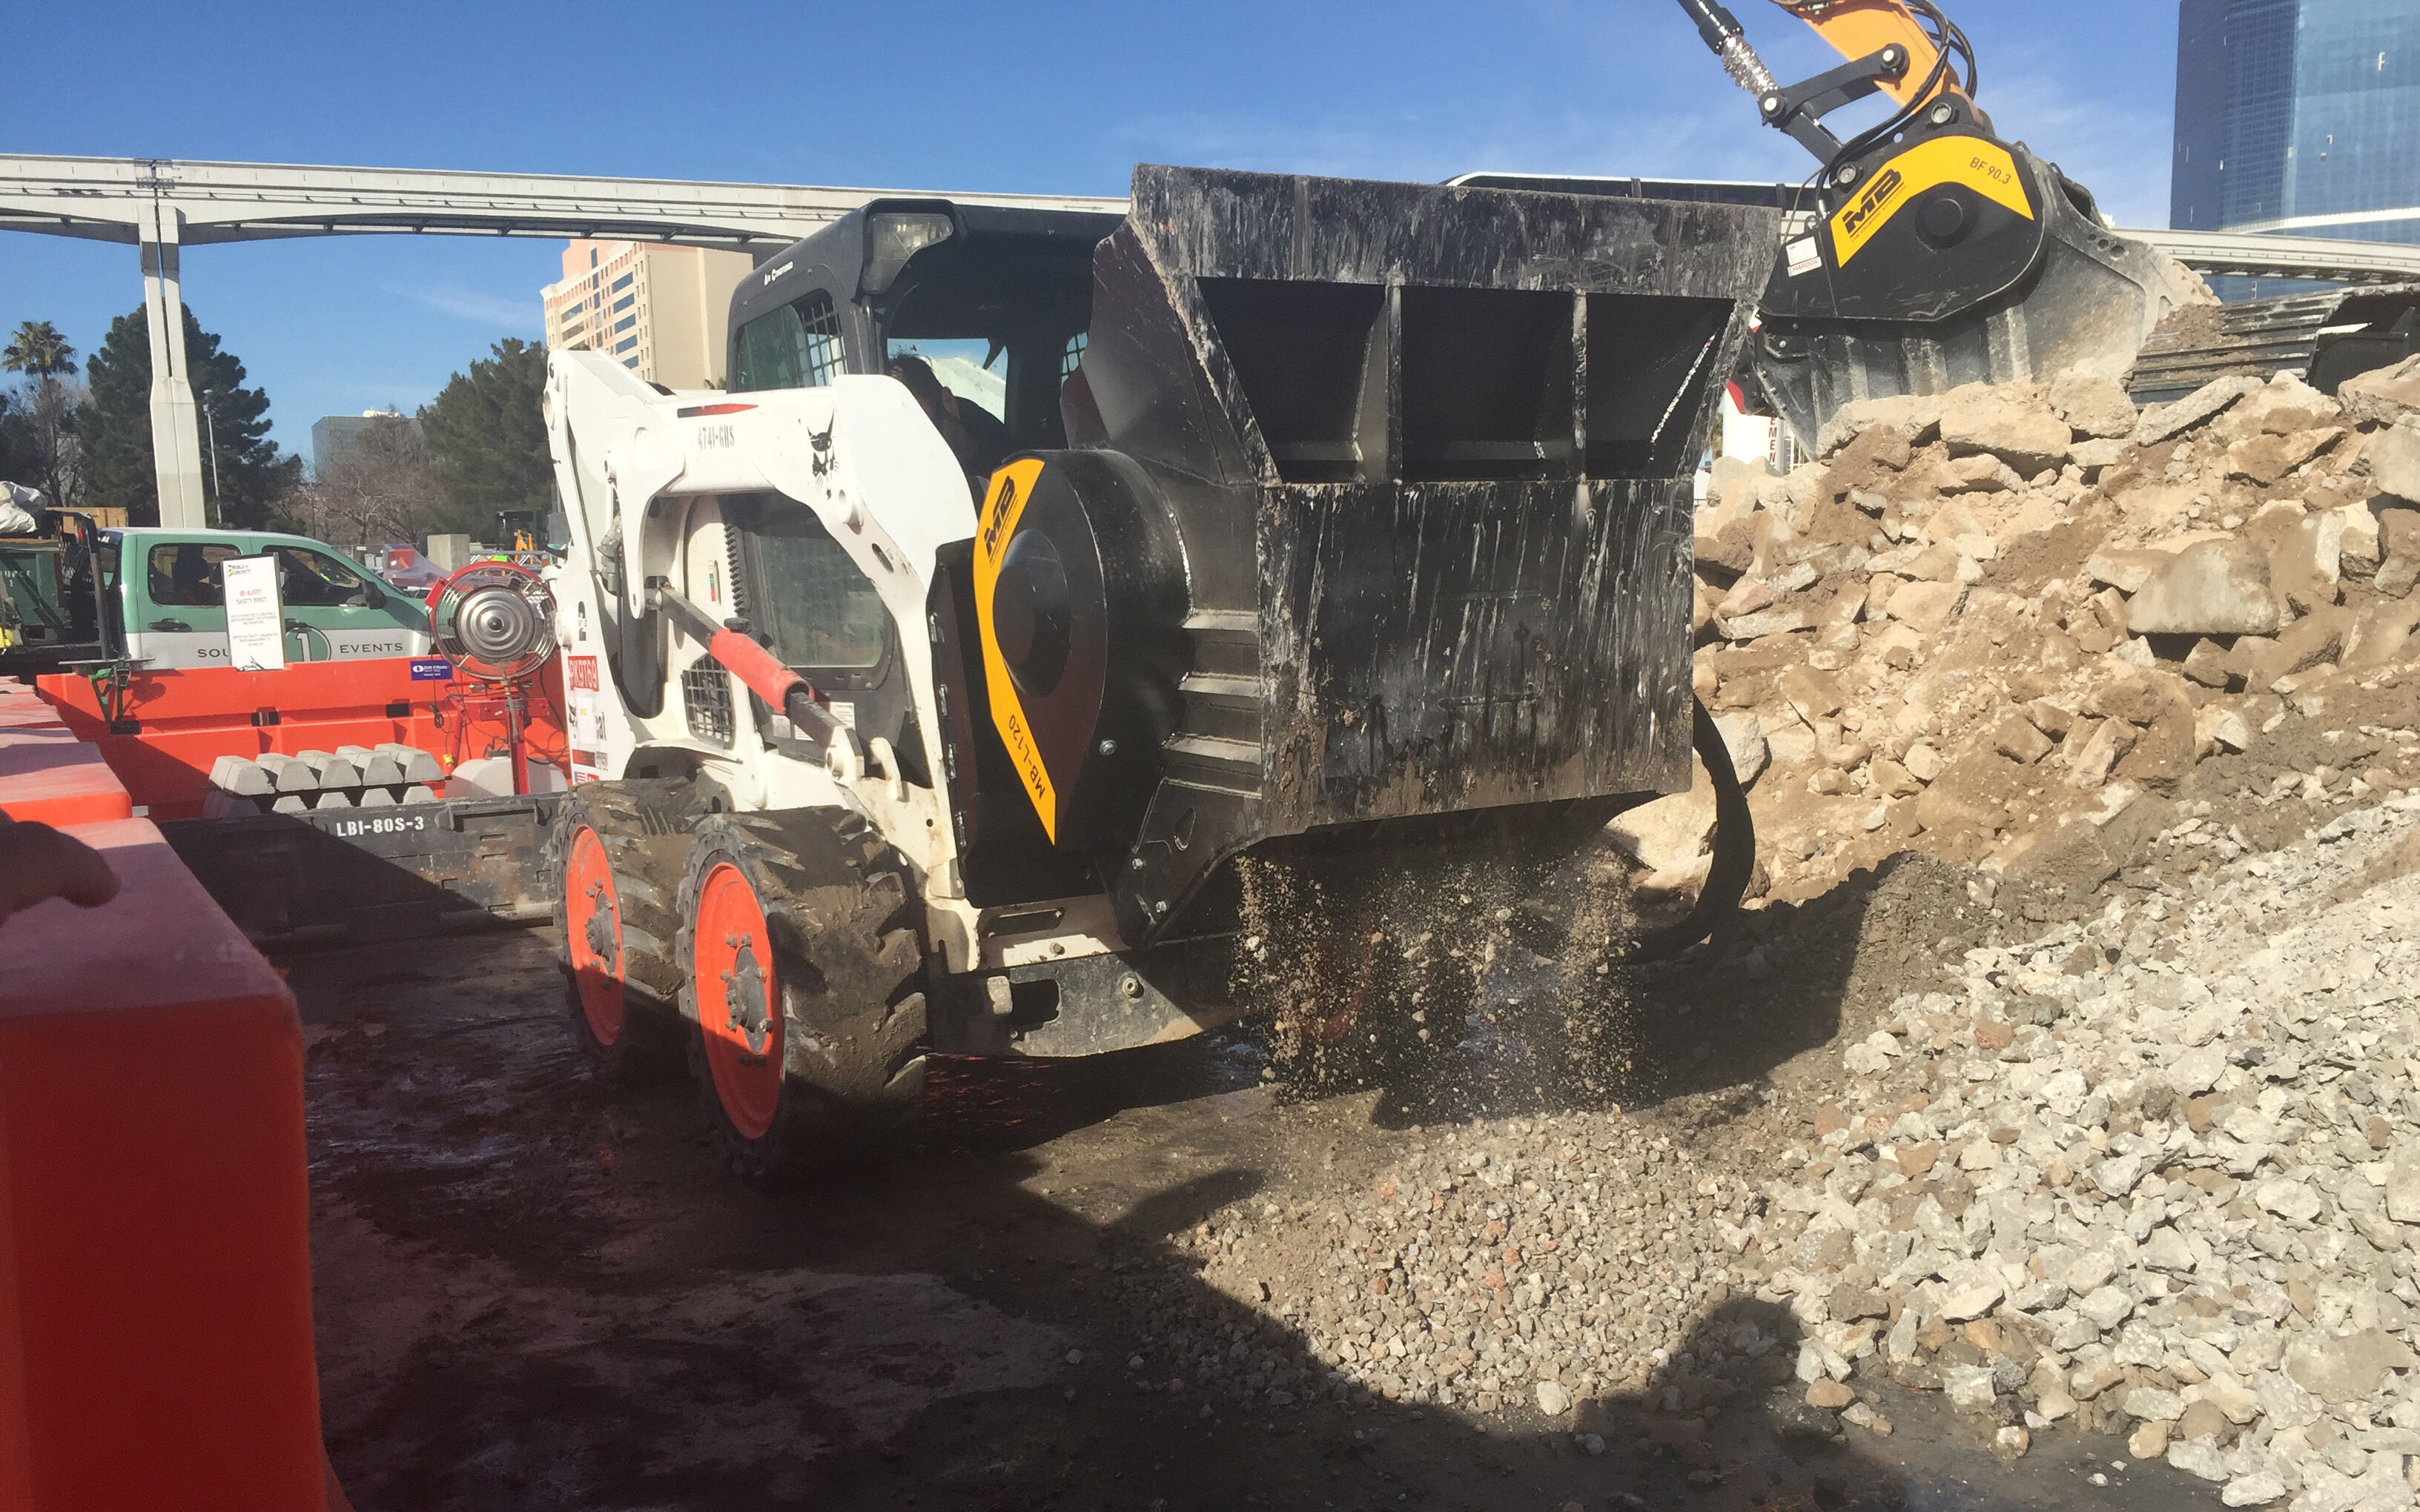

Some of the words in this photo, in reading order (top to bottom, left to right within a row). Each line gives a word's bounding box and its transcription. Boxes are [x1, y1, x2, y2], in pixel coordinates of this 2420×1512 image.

[1969, 157, 1987, 170] BF
[1988, 165, 2011, 185] 90.3
[1842, 169, 1902, 235] MB
[1768, 415, 1778, 466] EMEN
[984, 475, 1016, 559] MB
[340, 643, 403, 654] EVENTS
[1008, 714, 1046, 800] MB-L120
[336, 815, 425, 838] LBI-80S-3
